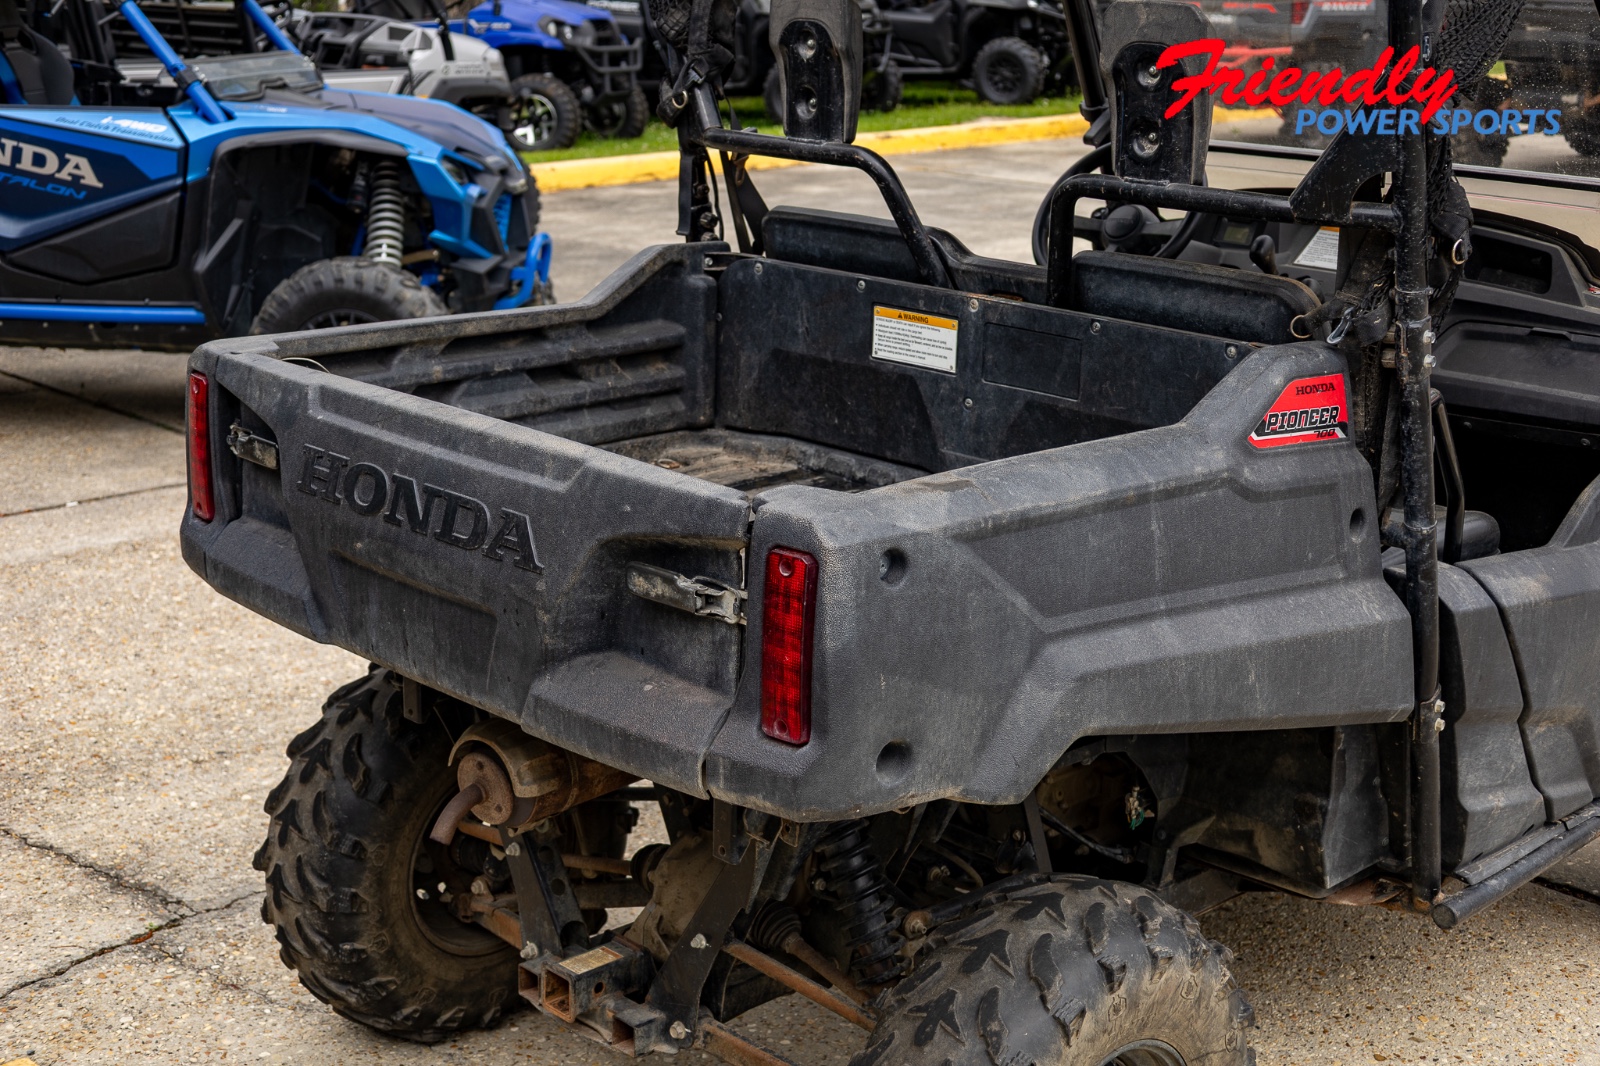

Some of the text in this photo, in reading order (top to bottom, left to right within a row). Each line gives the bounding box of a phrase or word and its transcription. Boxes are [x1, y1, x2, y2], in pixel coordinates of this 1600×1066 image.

[55, 116, 175, 142] Dual Clutch Transmission
[903, 313, 929, 324] WARNING
[1296, 382, 1336, 395] HONDA
[1265, 405, 1340, 432] PIONEER
[1313, 428, 1336, 438] 700
[296, 443, 545, 575] HONDA
